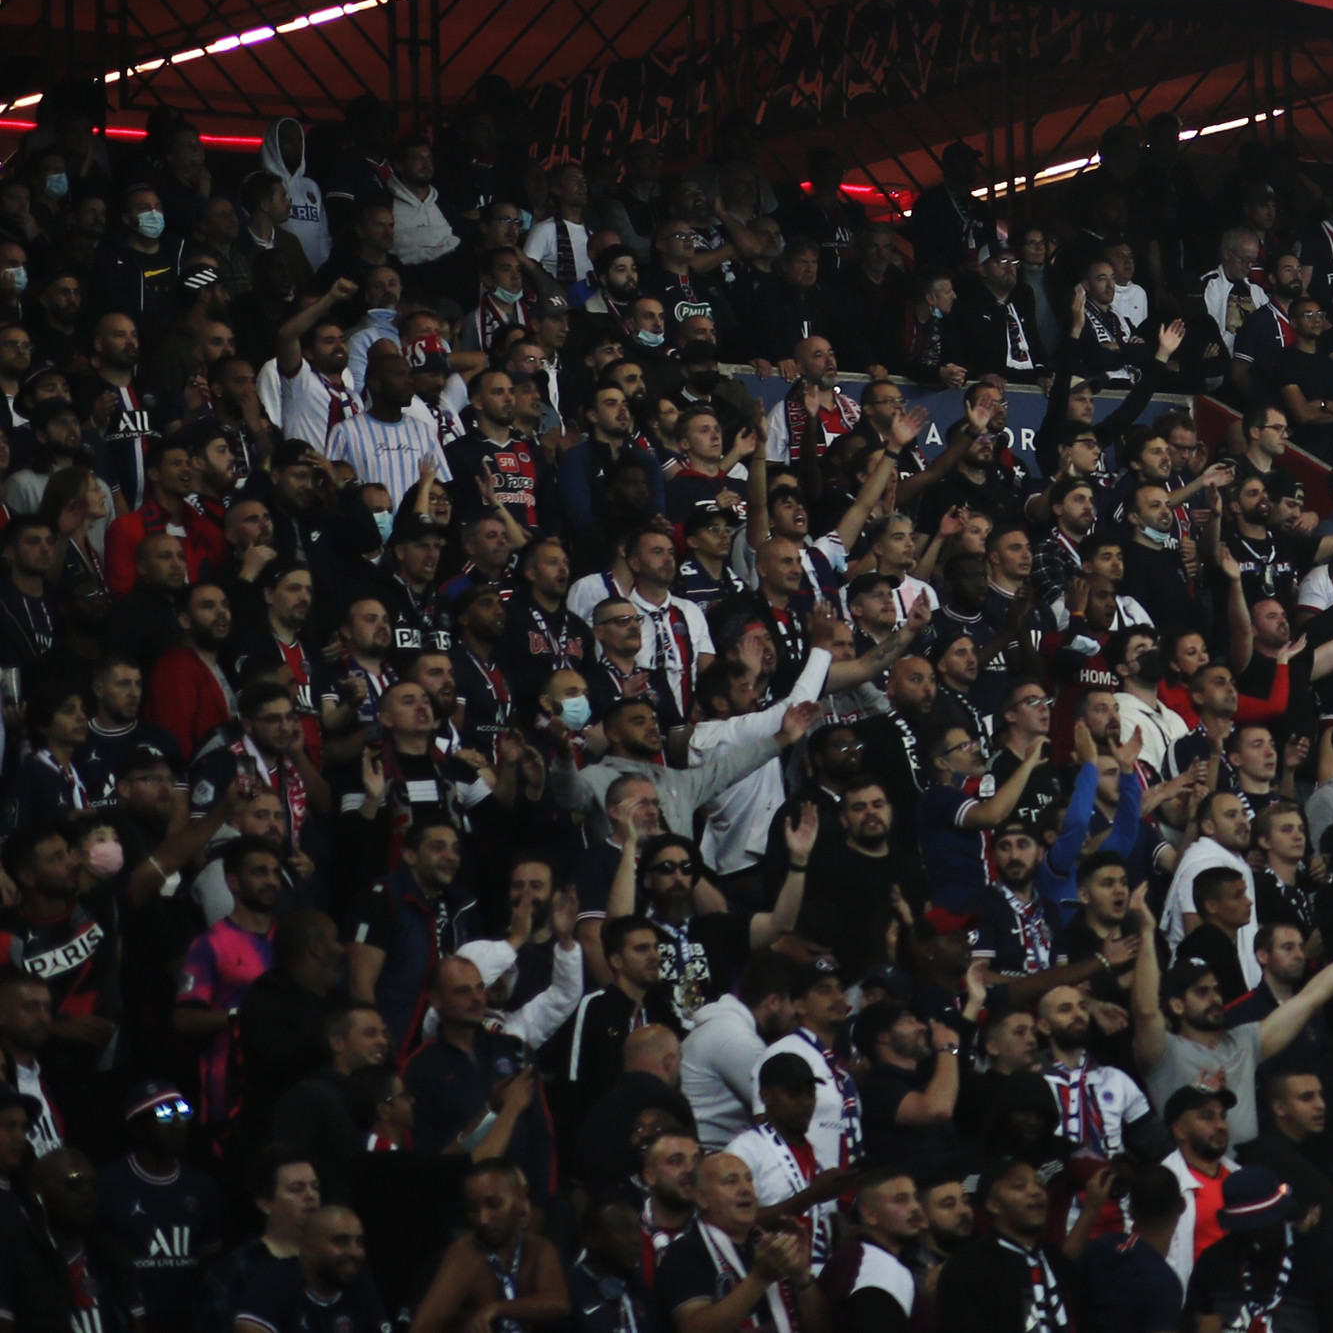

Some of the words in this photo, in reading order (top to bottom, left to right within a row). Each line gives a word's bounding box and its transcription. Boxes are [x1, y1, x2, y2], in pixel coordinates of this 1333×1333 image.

[924, 423, 1037, 452] AOR
[395, 628, 453, 651] PAIS
[25, 923, 104, 978] PARIS
